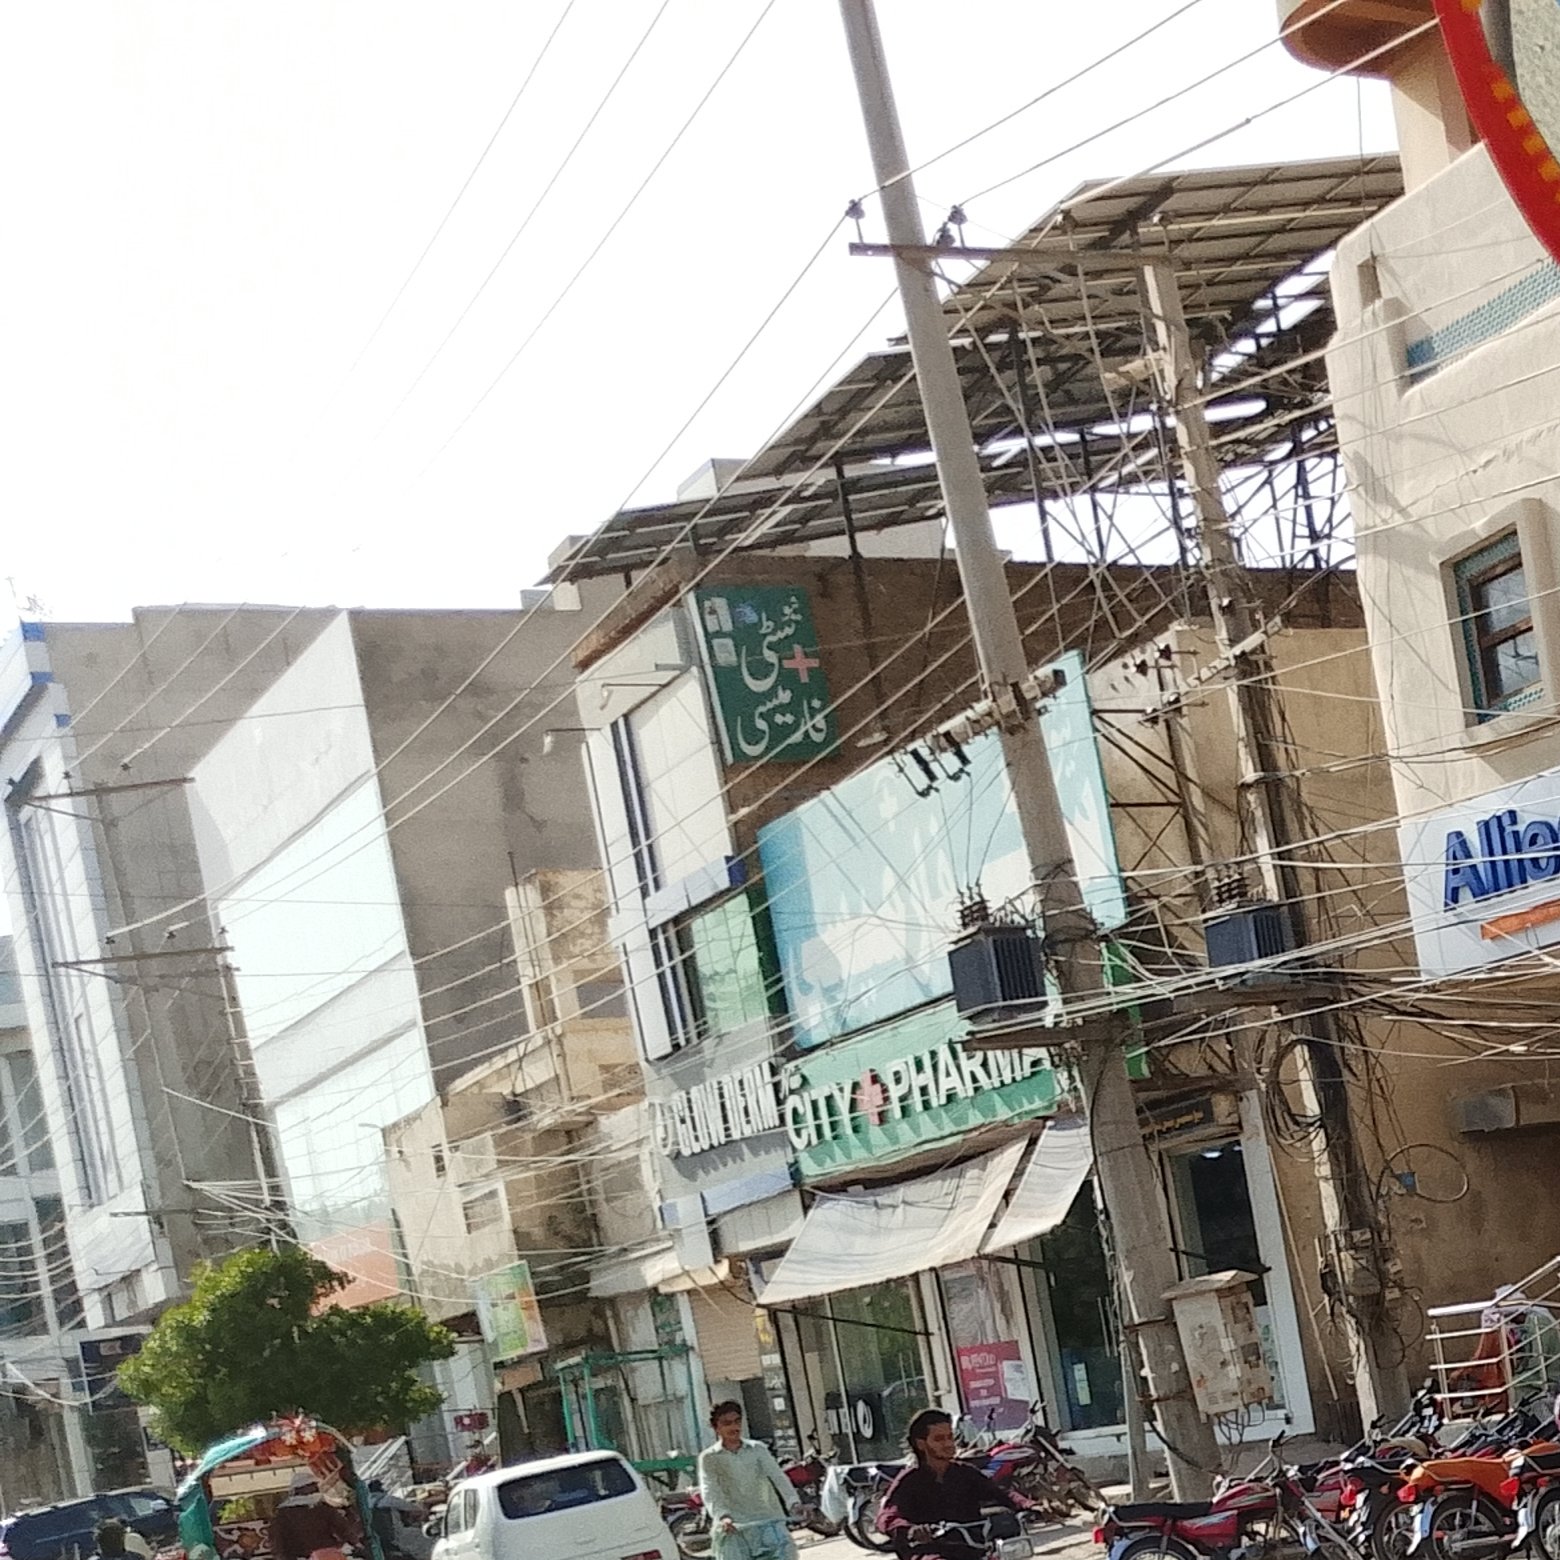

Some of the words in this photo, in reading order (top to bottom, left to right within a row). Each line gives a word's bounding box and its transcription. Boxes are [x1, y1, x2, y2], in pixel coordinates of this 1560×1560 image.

[740, 609, 798, 693] سٹی
[736, 685, 828, 757] فارمیسی
[1443, 809, 1560, 913] Allie
[672, 1077, 727, 1157] GLOW
[721, 1059, 780, 1140] DERM
[785, 1081, 854, 1150] CITY
